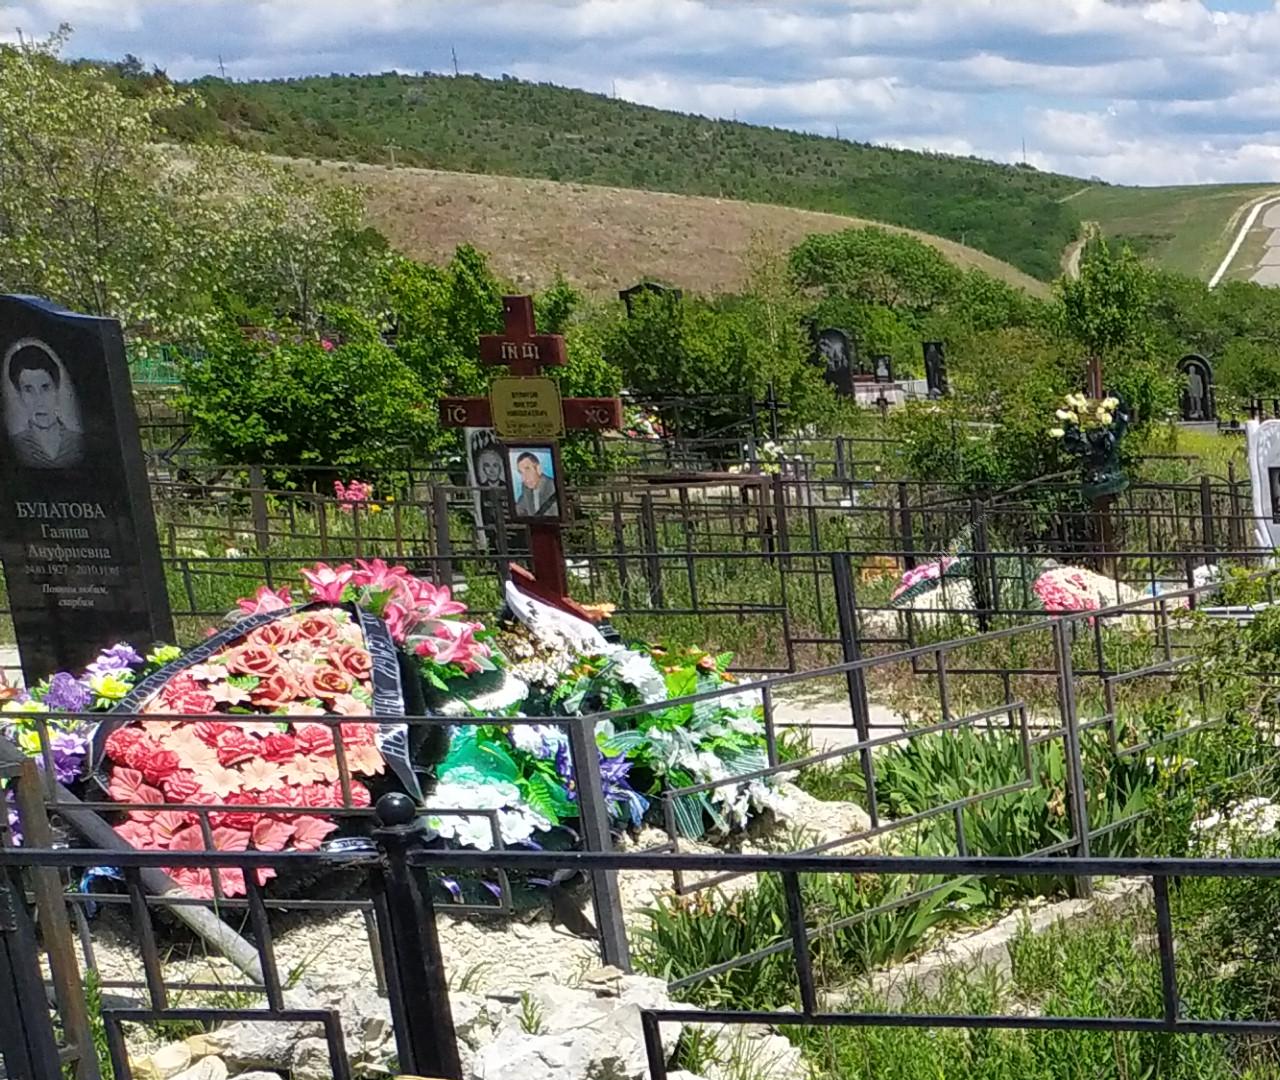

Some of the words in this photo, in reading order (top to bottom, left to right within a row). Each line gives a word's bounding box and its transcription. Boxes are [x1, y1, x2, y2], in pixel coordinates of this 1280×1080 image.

[16, 501, 107, 519] БУЛАТОВА
[40, 523, 90, 540] Галина
[28, 543, 112, 562] Ануфриевна
